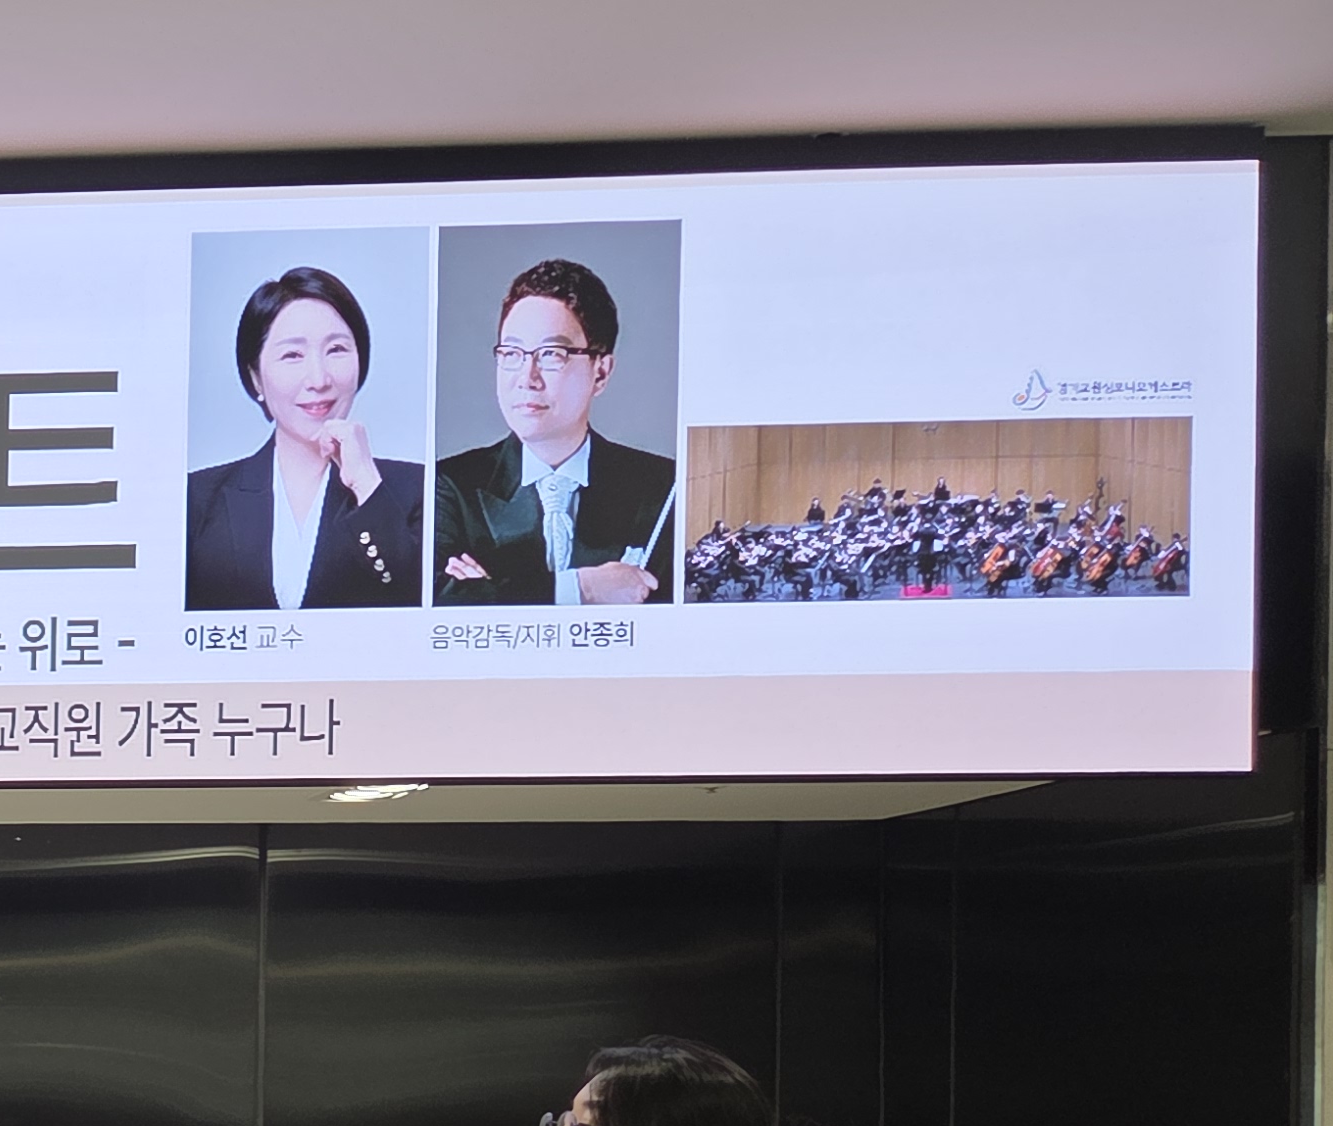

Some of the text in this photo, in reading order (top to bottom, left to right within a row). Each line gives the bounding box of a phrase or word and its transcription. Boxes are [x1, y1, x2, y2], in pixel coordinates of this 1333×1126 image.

[18, 616, 104, 672] 위로
[184, 624, 304, 652] 이호선 교수
[430, 621, 634, 650] 음악감독/지휘 안종희
[118, 700, 201, 758] 가족
[212, 698, 341, 757] 누구나
